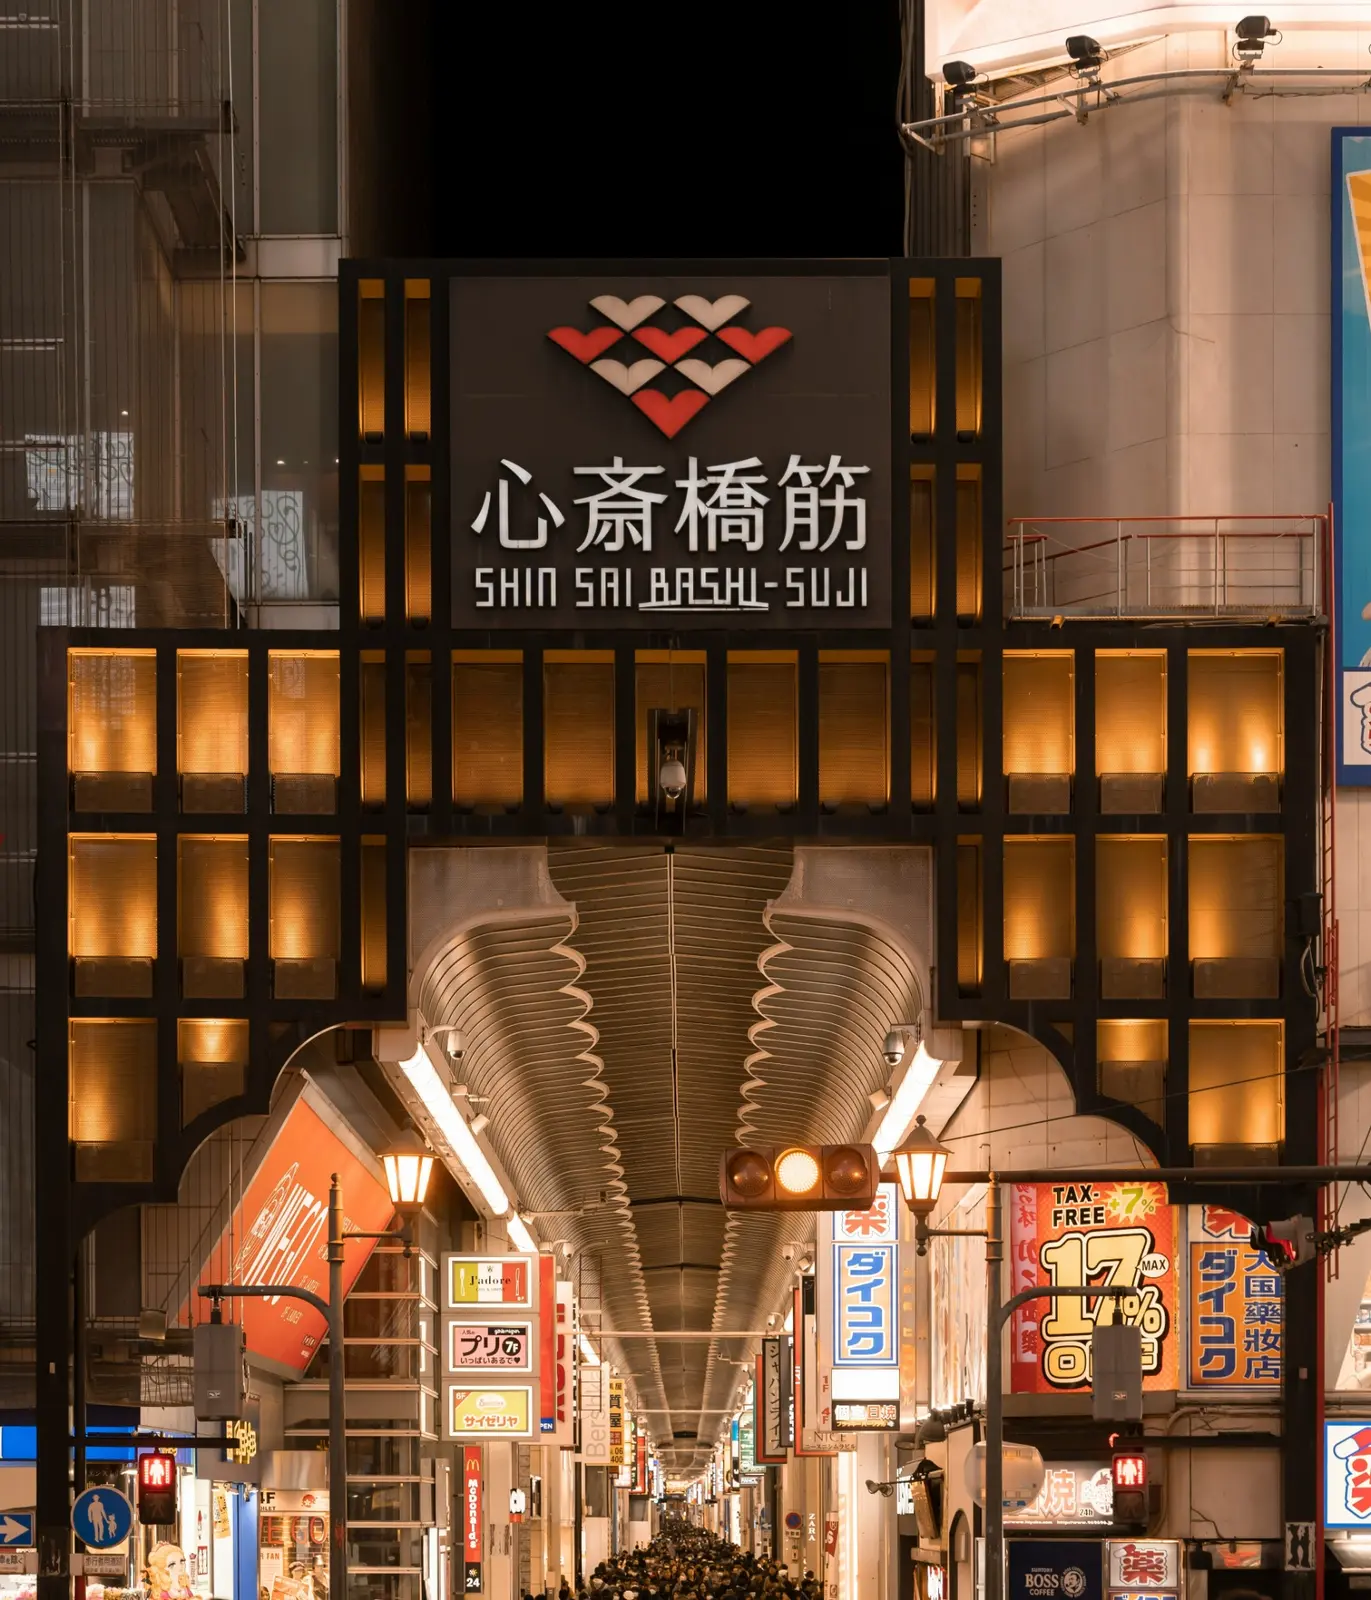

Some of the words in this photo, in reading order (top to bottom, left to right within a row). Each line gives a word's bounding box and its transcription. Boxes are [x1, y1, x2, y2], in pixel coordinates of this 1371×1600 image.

[470, 454, 871, 552] 心斎橋筋
[475, 567, 556, 607] SHIN
[575, 567, 632, 607] SAI
[1053, 1184, 1099, 1205] TAX-
[1052, 1206, 1105, 1227] FREE
[1142, 1259, 1166, 1271] MAX
[470, 1275, 511, 1286] J'adore
[847, 1251, 886, 1356] ダイコク
[1199, 1249, 1237, 1379] ダイコク
[461, 1335, 500, 1357] プリ
[505, 1341, 519, 1353] 7F
[464, 1414, 518, 1427] サイゼリヤ
[468, 1479, 478, 1548] McDonald's
[260, 1516, 328, 1545] EGO
[808, 1513, 816, 1541] ZARA
[1122, 1546, 1165, 1584] 薬
[466, 1577, 480, 1587] 24
[1025, 1574, 1060, 1588] BOSS
[1029, 1588, 1055, 1597] COFFEE
